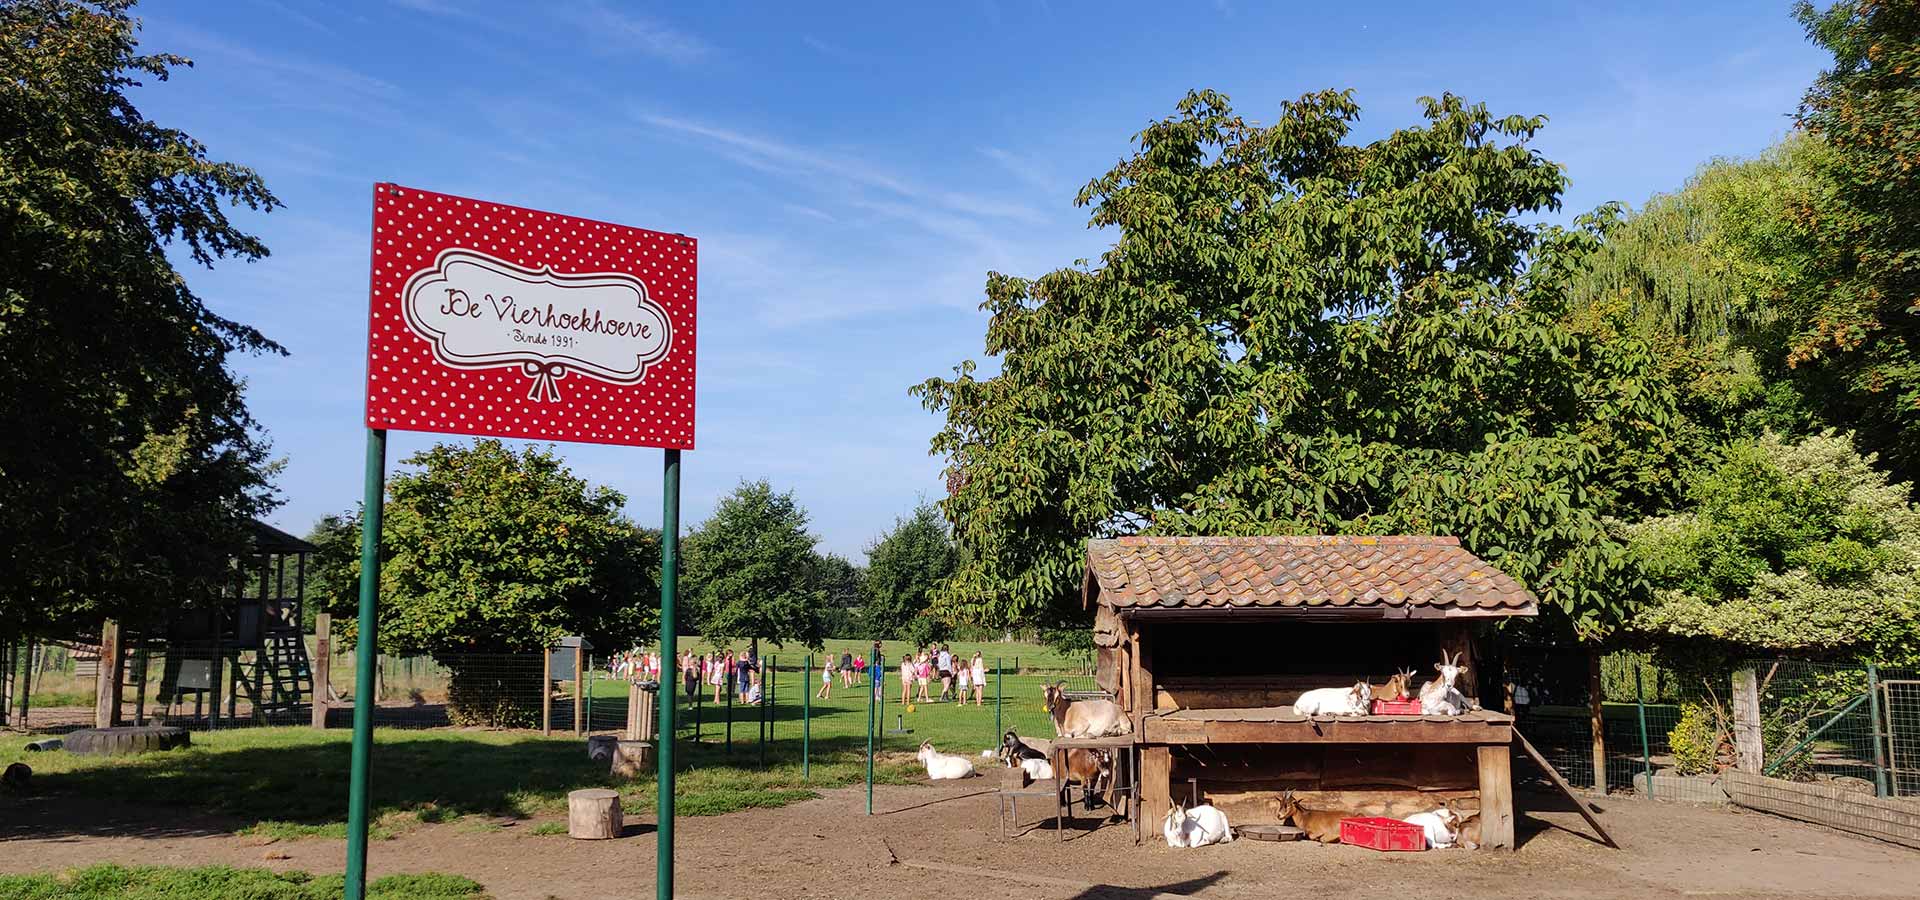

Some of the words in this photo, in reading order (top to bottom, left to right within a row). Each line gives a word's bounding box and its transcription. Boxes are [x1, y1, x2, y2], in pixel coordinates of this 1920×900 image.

[440, 288, 482, 318] De
[484, 294, 652, 339] Vierhoekhoeve
[512, 328, 548, 345] Sinds
[551, 334, 573, 348] 1991
